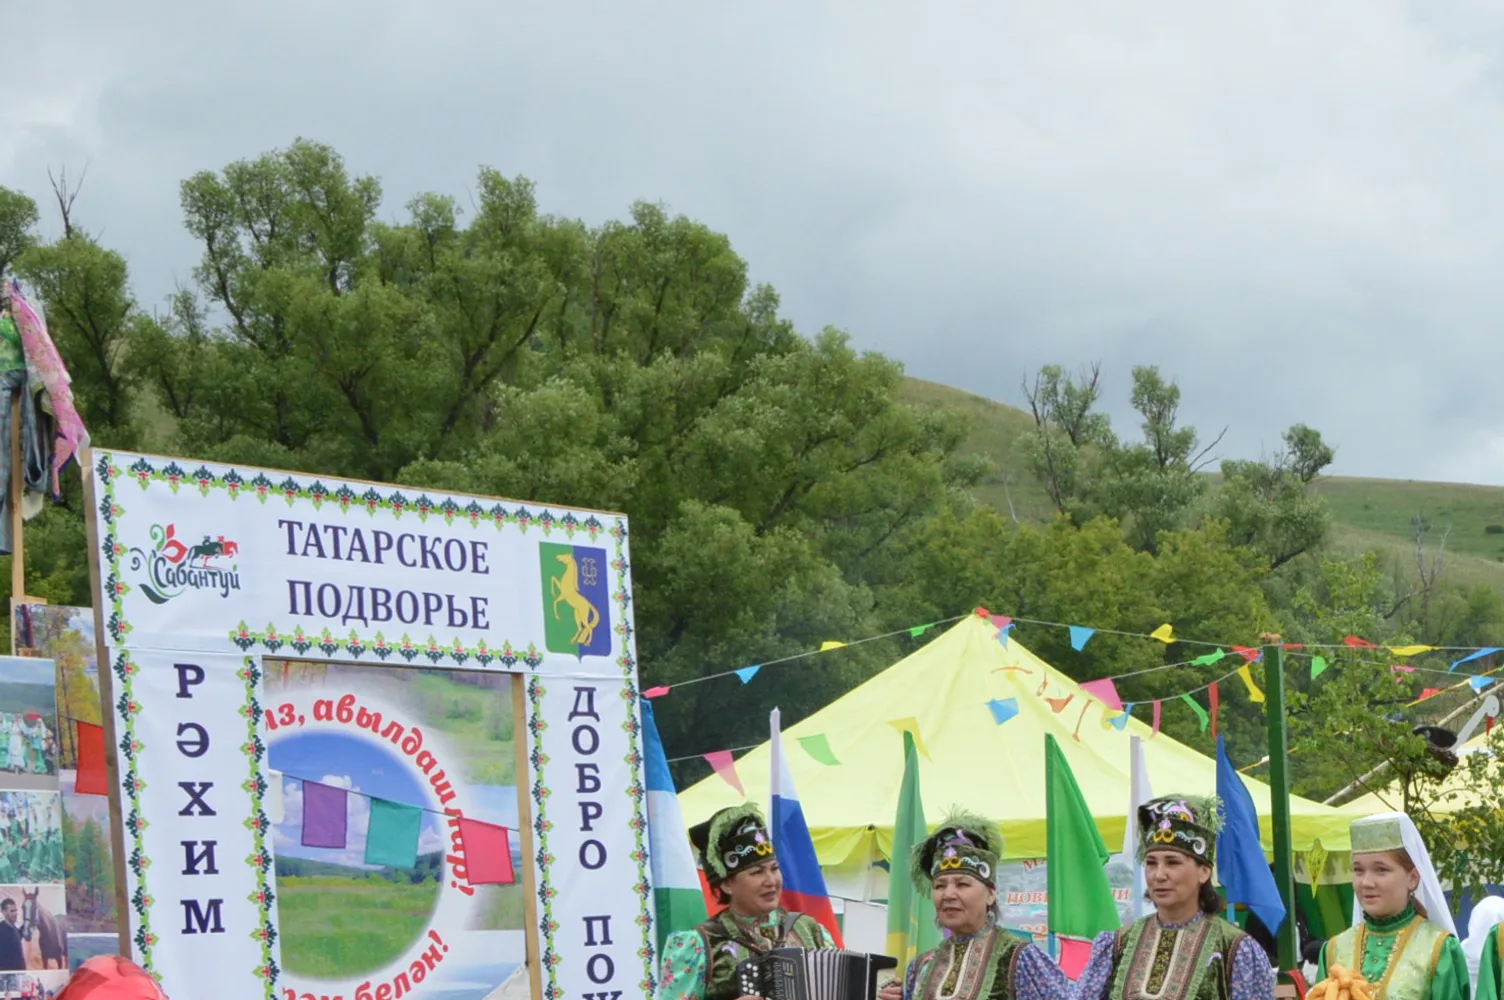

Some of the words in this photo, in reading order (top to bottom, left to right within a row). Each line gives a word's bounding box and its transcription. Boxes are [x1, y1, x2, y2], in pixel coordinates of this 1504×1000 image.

[278, 519, 490, 575] ТАТАРСКОЕ
[153, 556, 240, 599] Сабантуй
[287, 579, 490, 631] ПОДВОРЬЕ
[173, 663, 226, 936] РӘХИМ
[568, 685, 607, 871] ДОБРО
